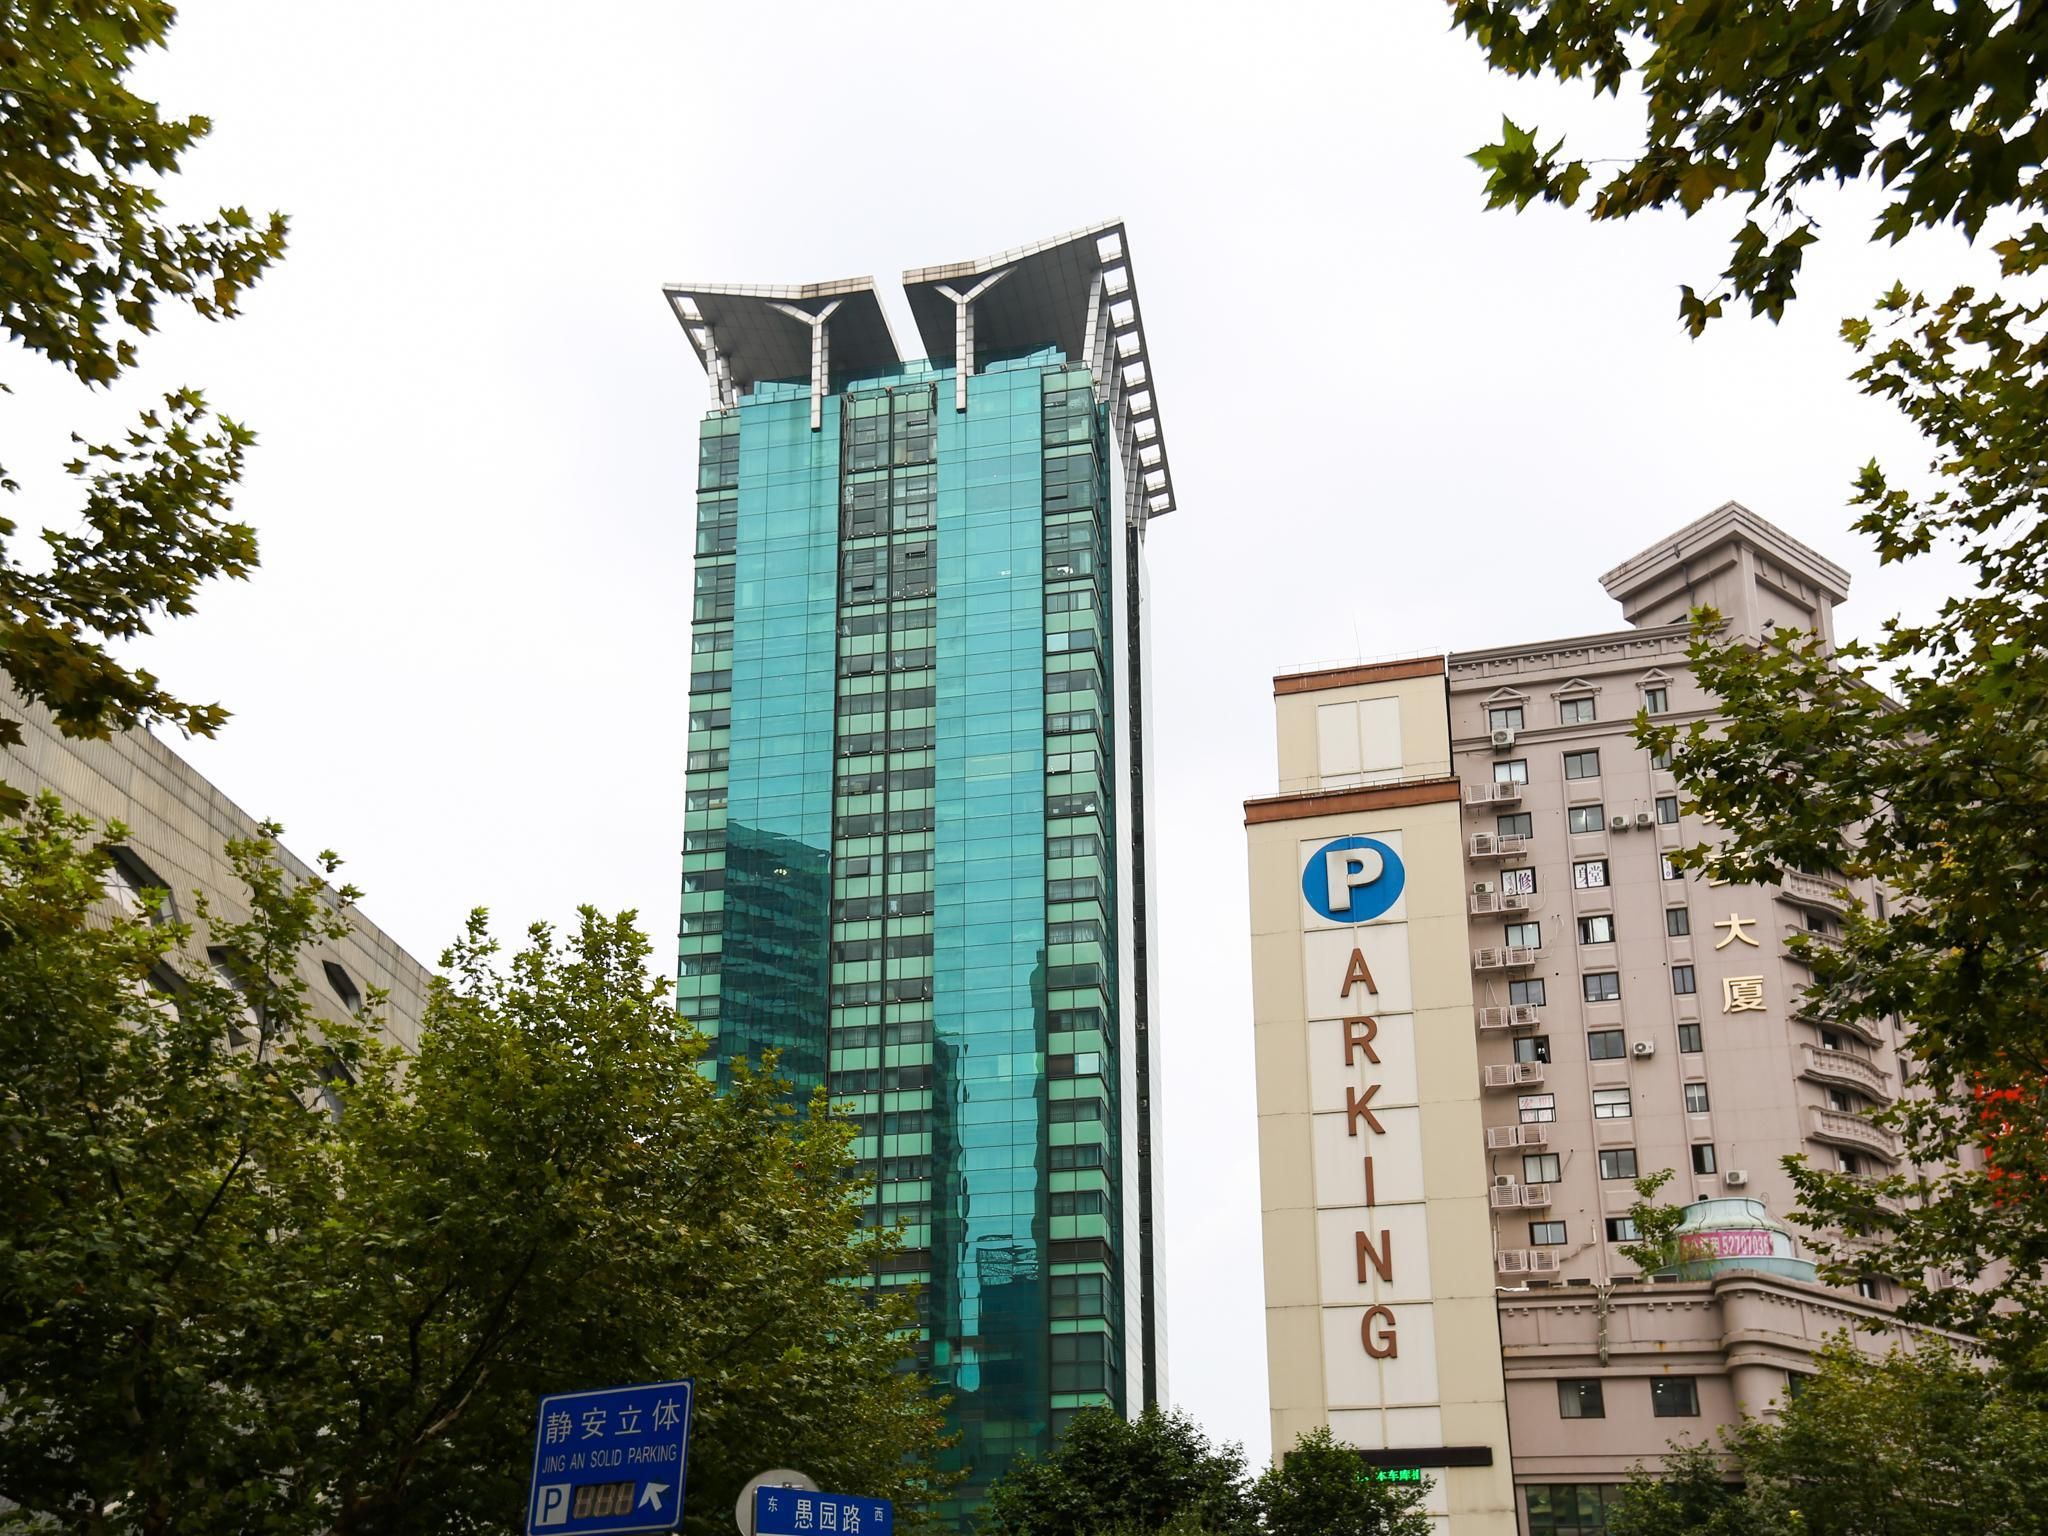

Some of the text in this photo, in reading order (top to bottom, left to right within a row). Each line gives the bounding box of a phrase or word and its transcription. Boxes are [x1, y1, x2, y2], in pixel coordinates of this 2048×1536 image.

[546, 1398, 681, 1445] 静安立体
[542, 1444, 677, 1474] JING AN SOLID PARKING
[542, 1488, 562, 1523] P
[768, 1496, 884, 1534] 东 愚园路 西
